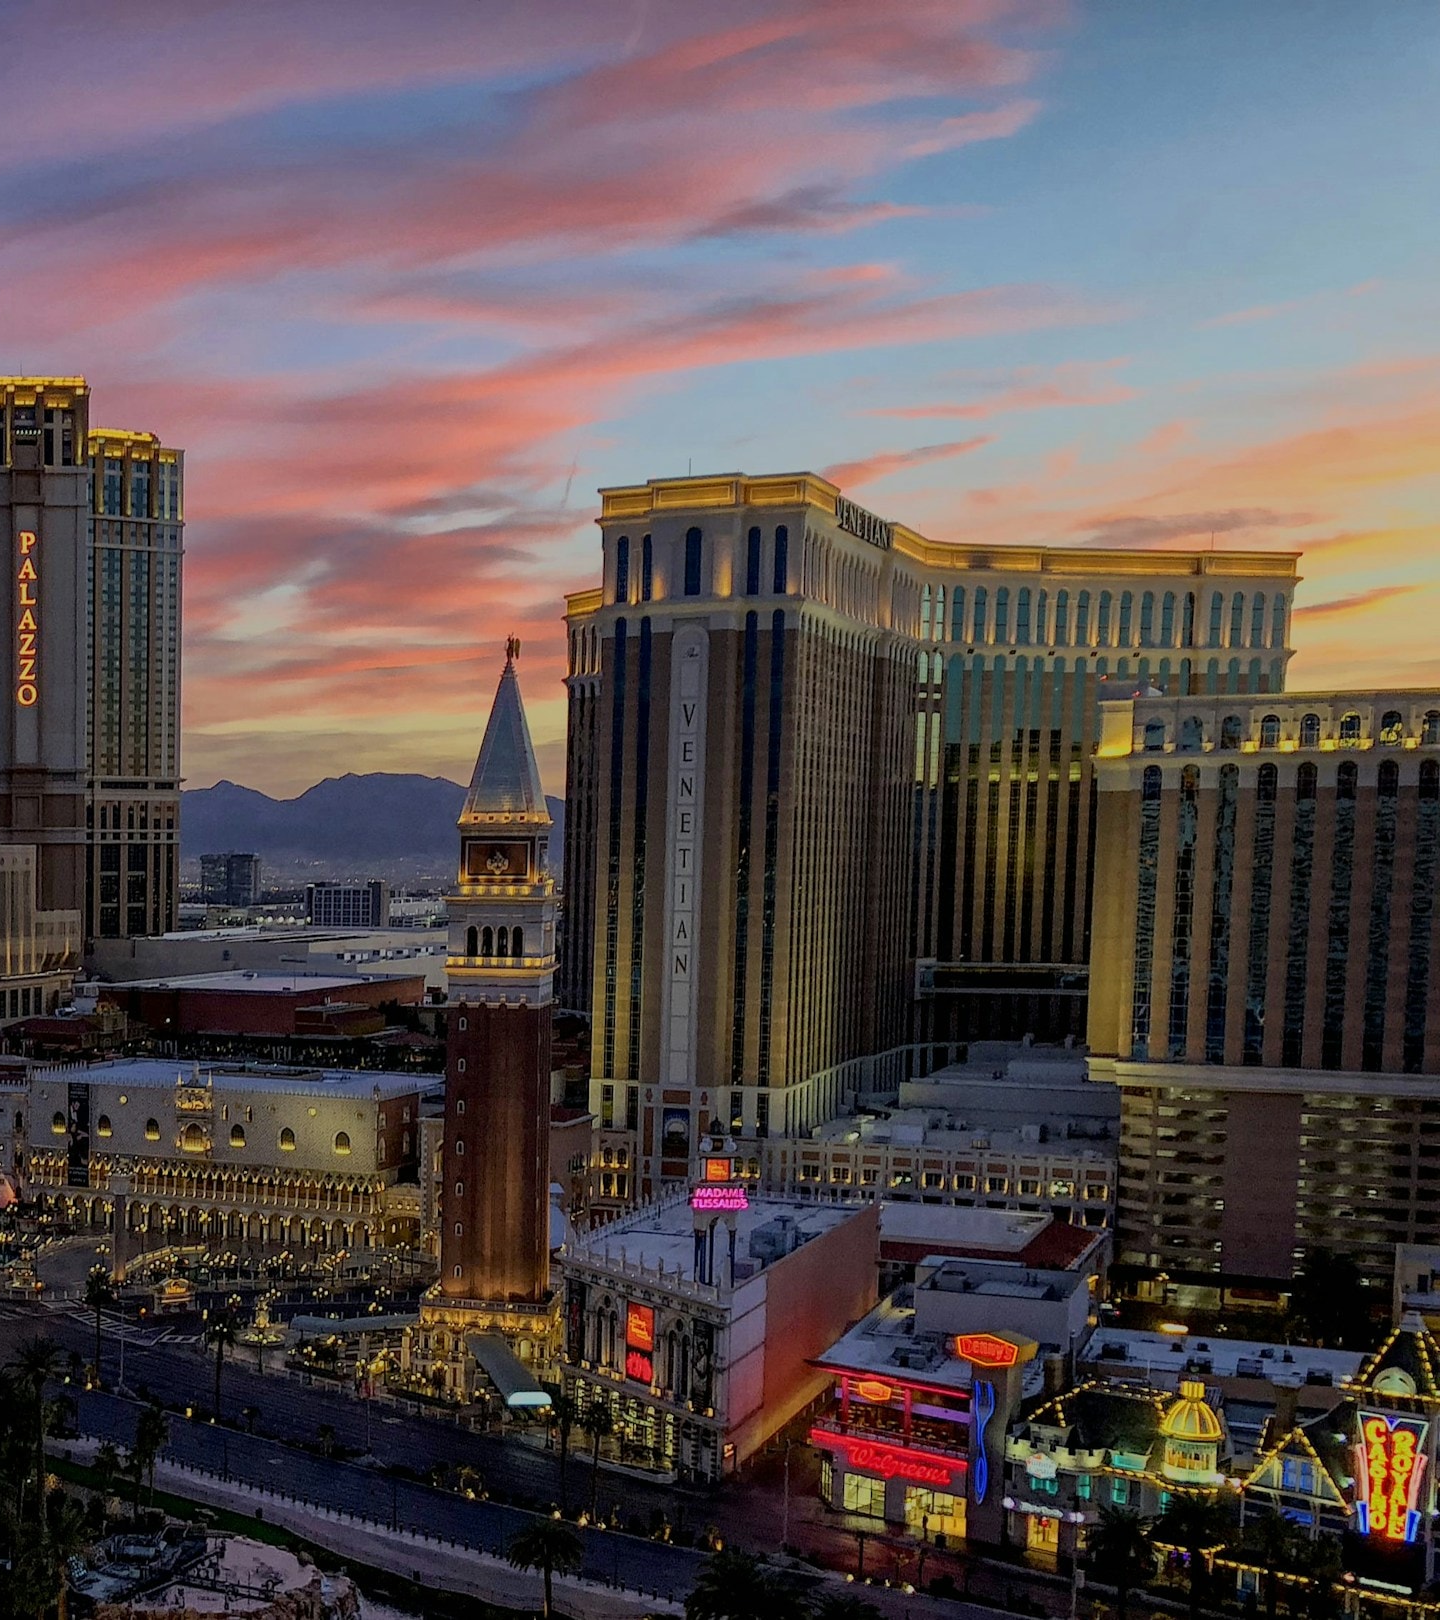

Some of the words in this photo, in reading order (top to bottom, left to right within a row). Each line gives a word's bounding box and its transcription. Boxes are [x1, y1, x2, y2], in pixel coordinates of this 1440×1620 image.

[836, 494, 888, 548] VENETIAN
[17, 530, 38, 706] PALAZZO
[674, 703, 697, 975] VENETIAN
[695, 1188, 745, 1198] MADAME
[962, 1339, 1015, 1360] Denny's
[849, 1445, 952, 1484] Walgreens
[1365, 1420, 1387, 1530] CASINO
[1386, 1431, 1415, 1539] ROYALE
